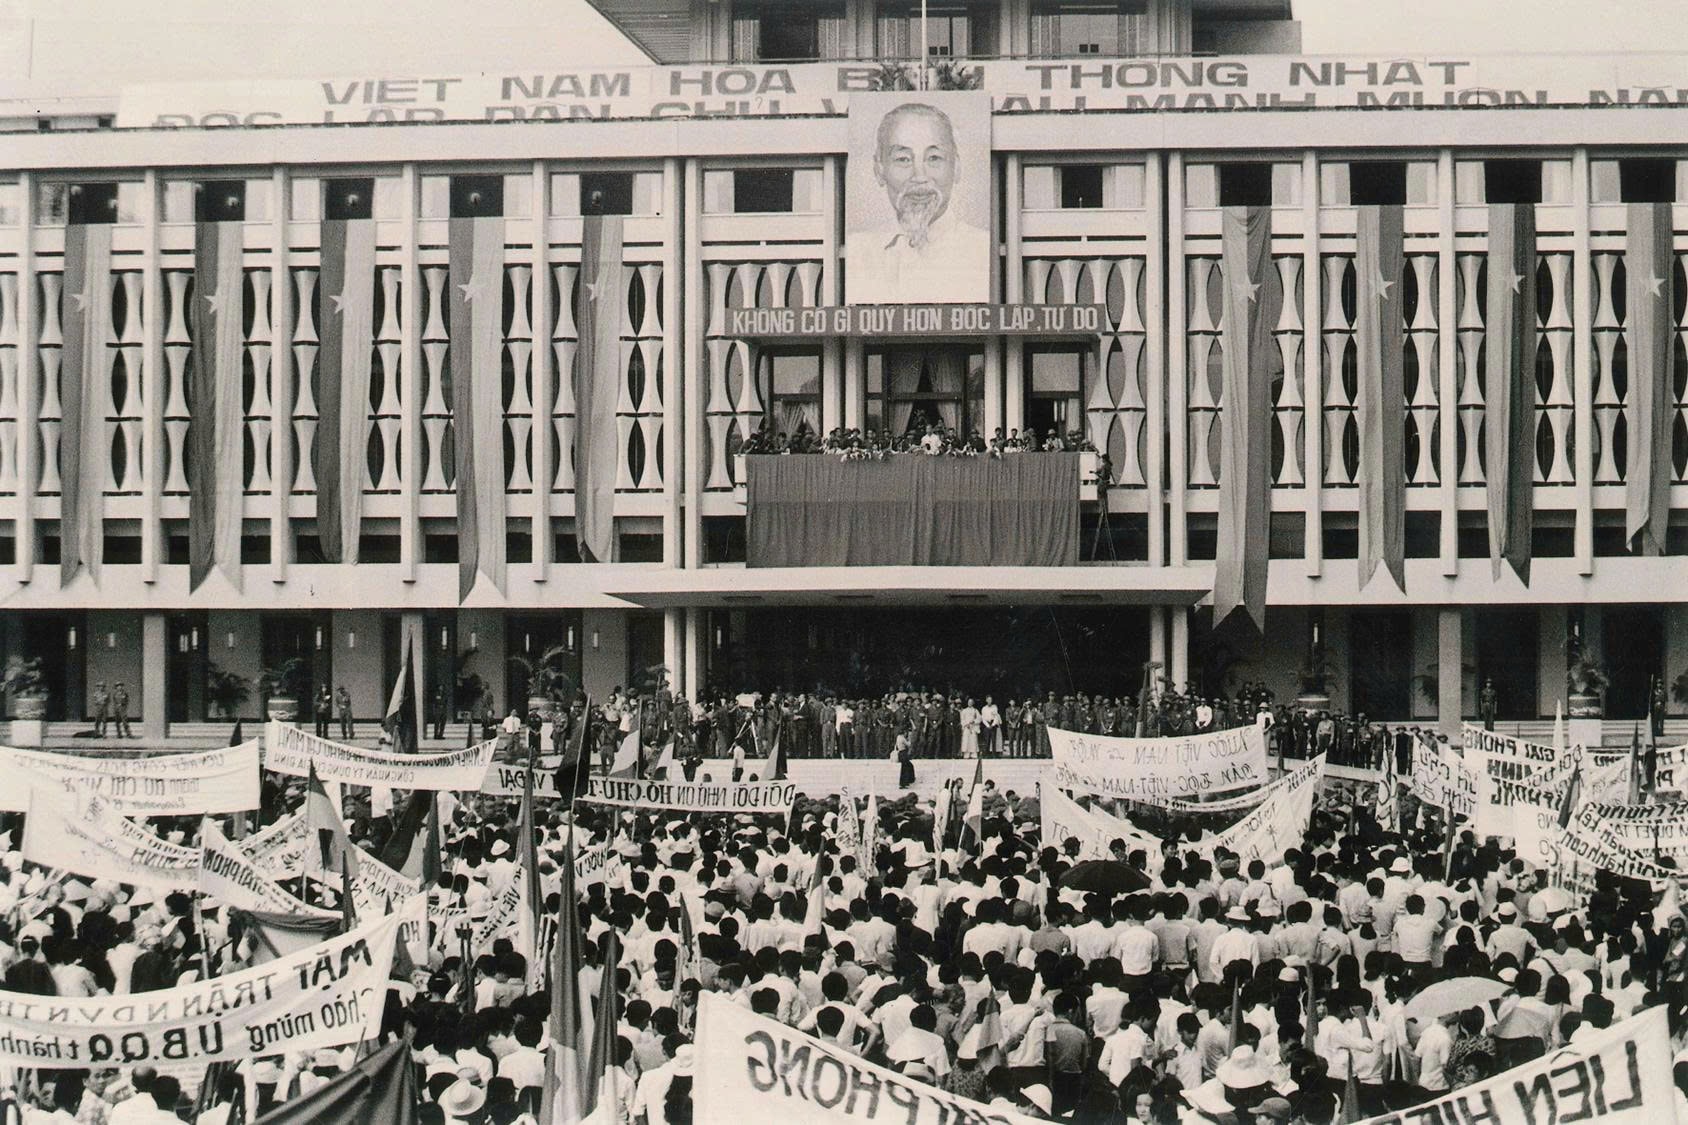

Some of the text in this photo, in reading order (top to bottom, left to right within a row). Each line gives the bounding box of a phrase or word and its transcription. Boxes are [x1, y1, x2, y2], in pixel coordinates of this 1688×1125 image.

[500, 72, 631, 101] NAM
[732, 308, 795, 334] KHÔNG
[801, 307, 826, 333] CÓ
[859, 306, 895, 335] QUÝ
[951, 305, 991, 332] ĐỘC
[1072, 307, 1098, 330] DO
